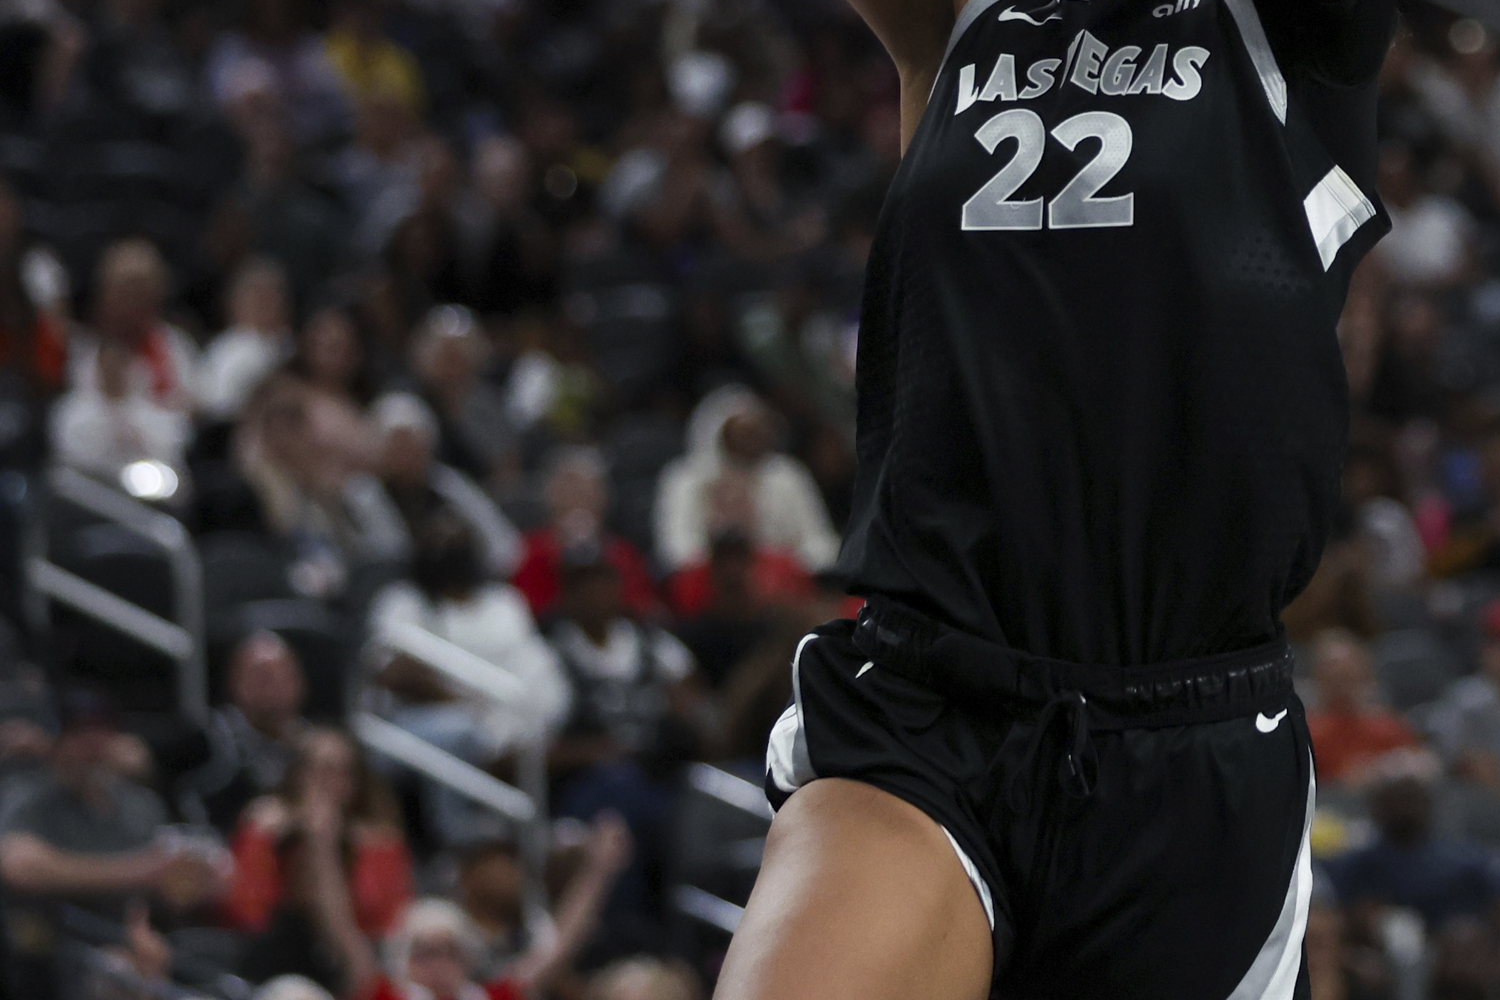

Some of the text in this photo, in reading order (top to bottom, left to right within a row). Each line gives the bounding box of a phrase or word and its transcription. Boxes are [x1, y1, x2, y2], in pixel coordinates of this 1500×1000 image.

[954, 28, 1212, 116] LAS VEGAS
[961, 107, 1135, 231] 22
